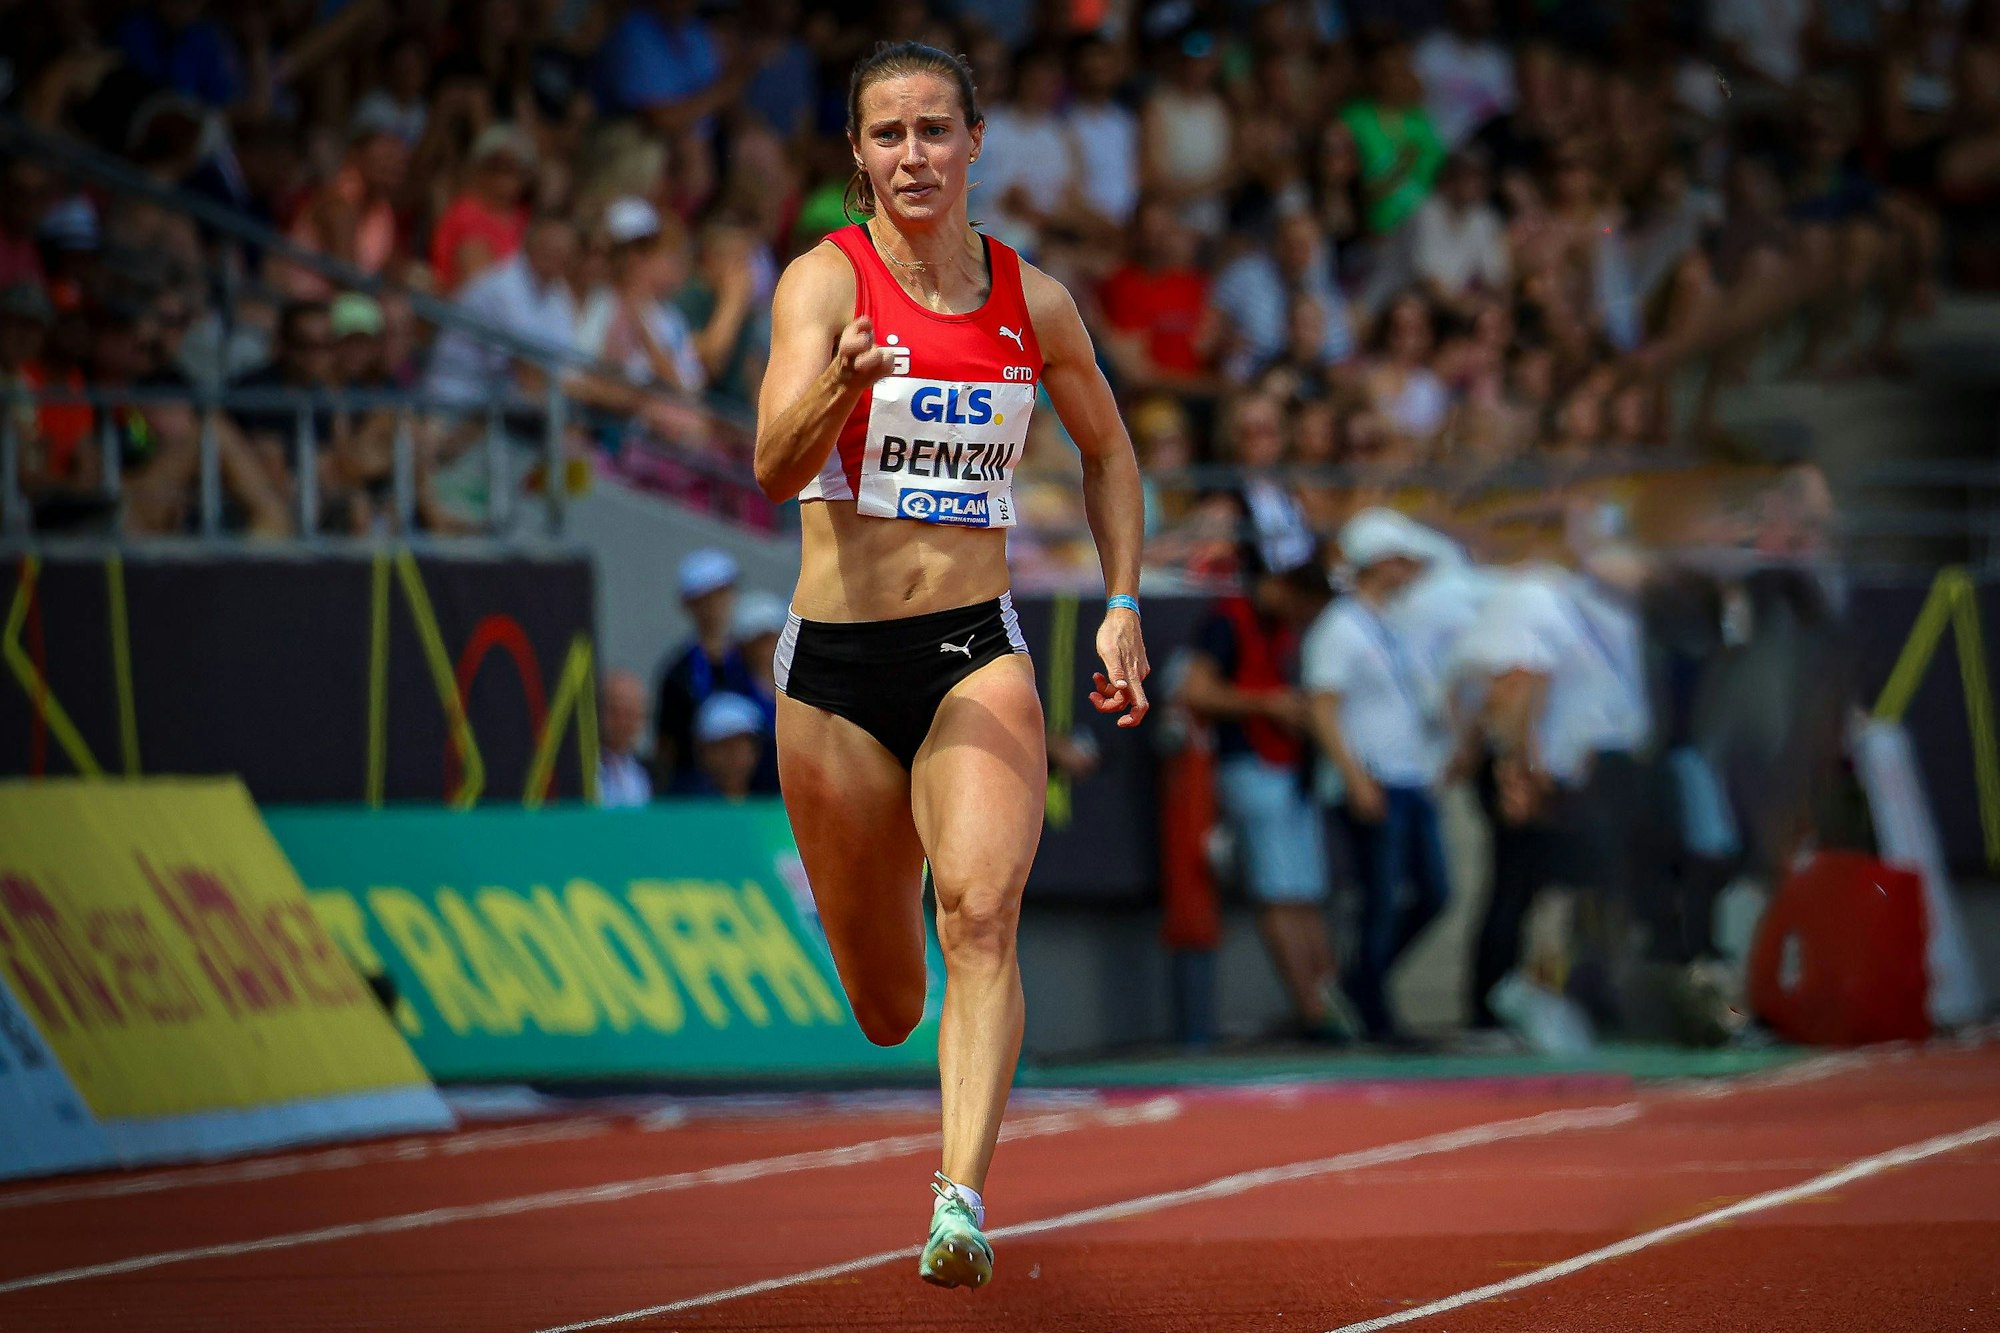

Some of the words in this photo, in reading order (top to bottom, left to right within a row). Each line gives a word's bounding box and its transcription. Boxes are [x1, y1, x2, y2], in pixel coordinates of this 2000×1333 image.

[1003, 365, 1033, 380] GfTD
[879, 435, 1015, 481] BENZIN
[939, 497, 986, 515] PLAN
[998, 497, 1009, 521] 734
[938, 514, 987, 523] INTERNATIONAL
[368, 879, 684, 1036] RADIO
[629, 879, 845, 1028] FFH
